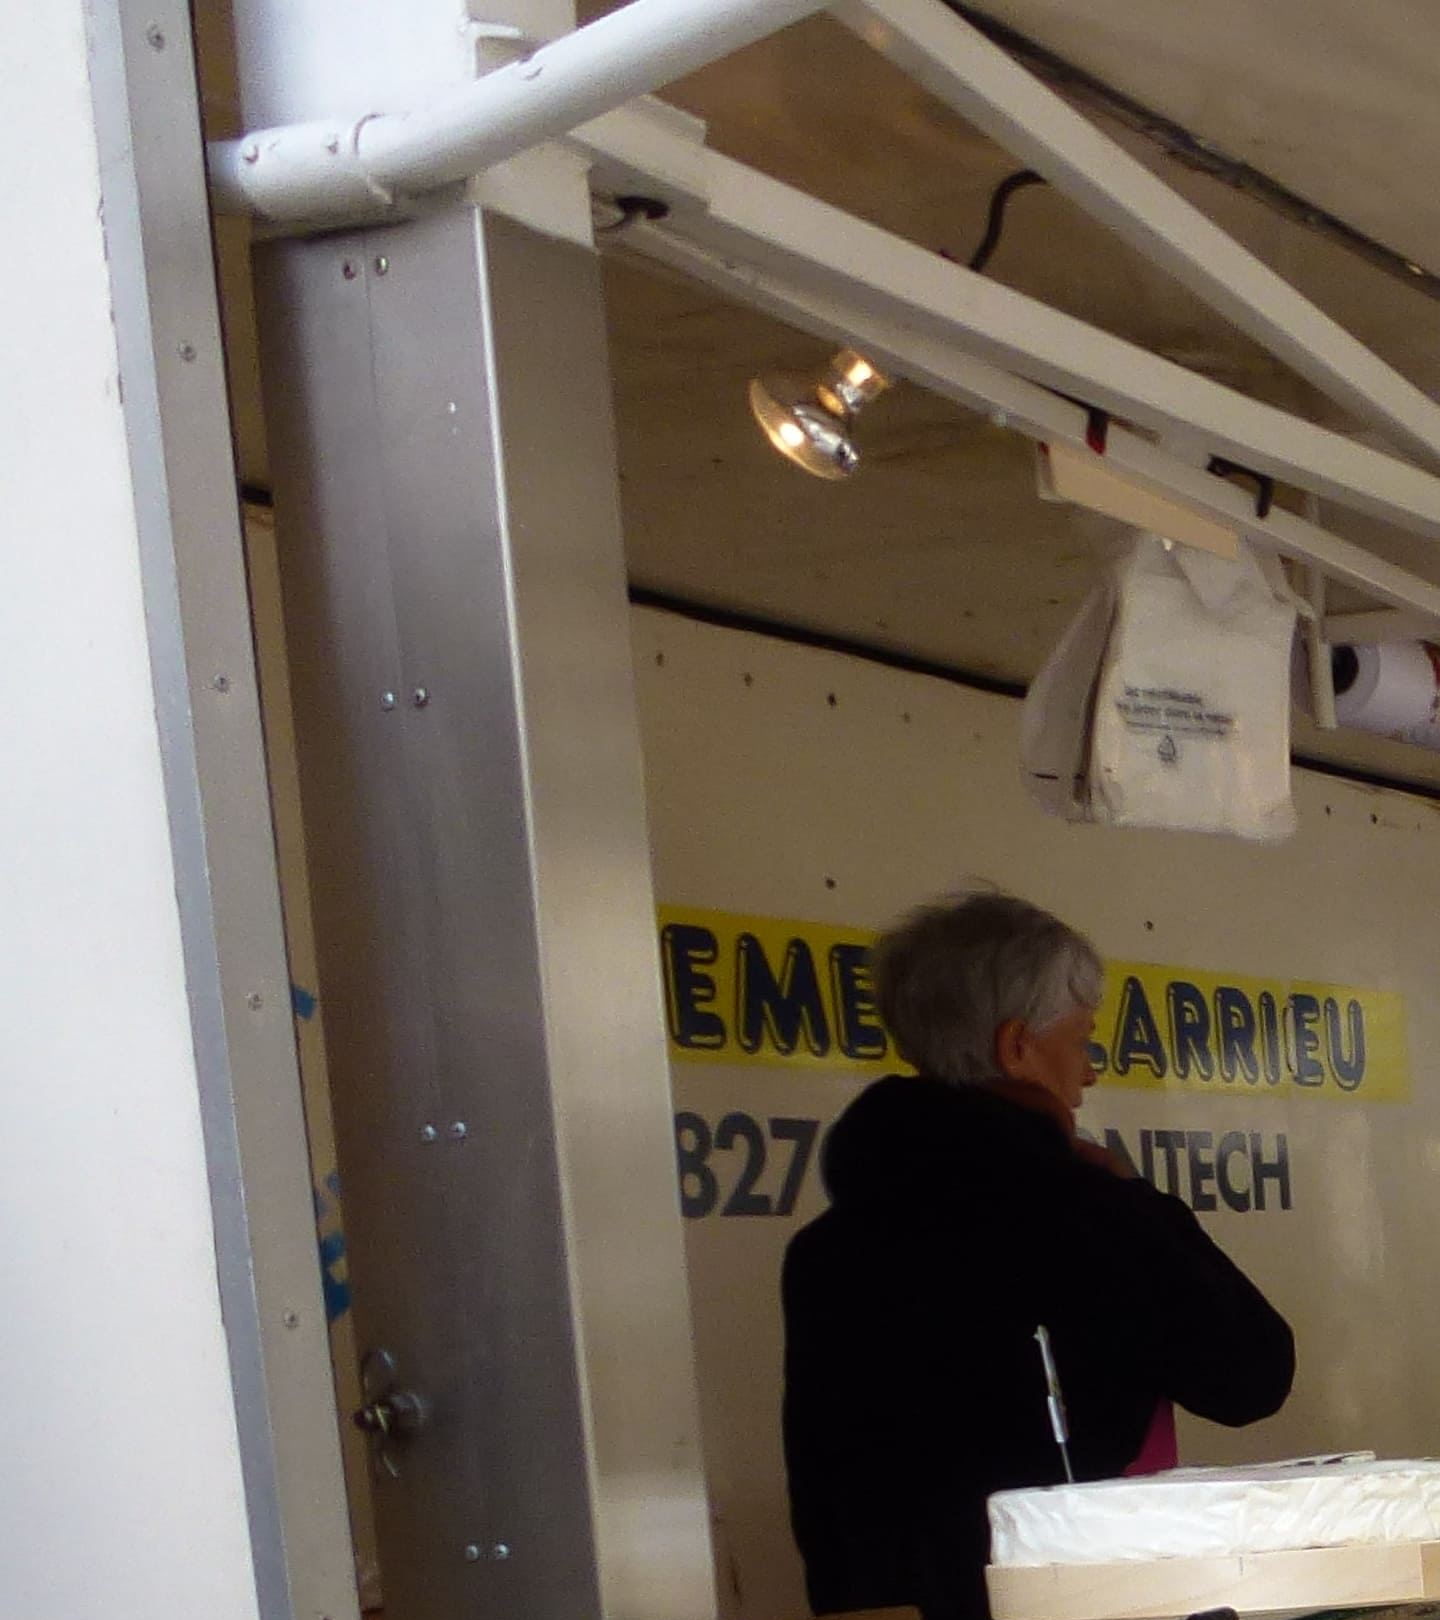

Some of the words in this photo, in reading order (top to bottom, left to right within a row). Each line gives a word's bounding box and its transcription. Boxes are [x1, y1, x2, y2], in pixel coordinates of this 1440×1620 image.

[661, 923, 888, 1060] EME
[675, 1111, 820, 1218] 827
[1076, 1128, 1291, 1213] NTECH
